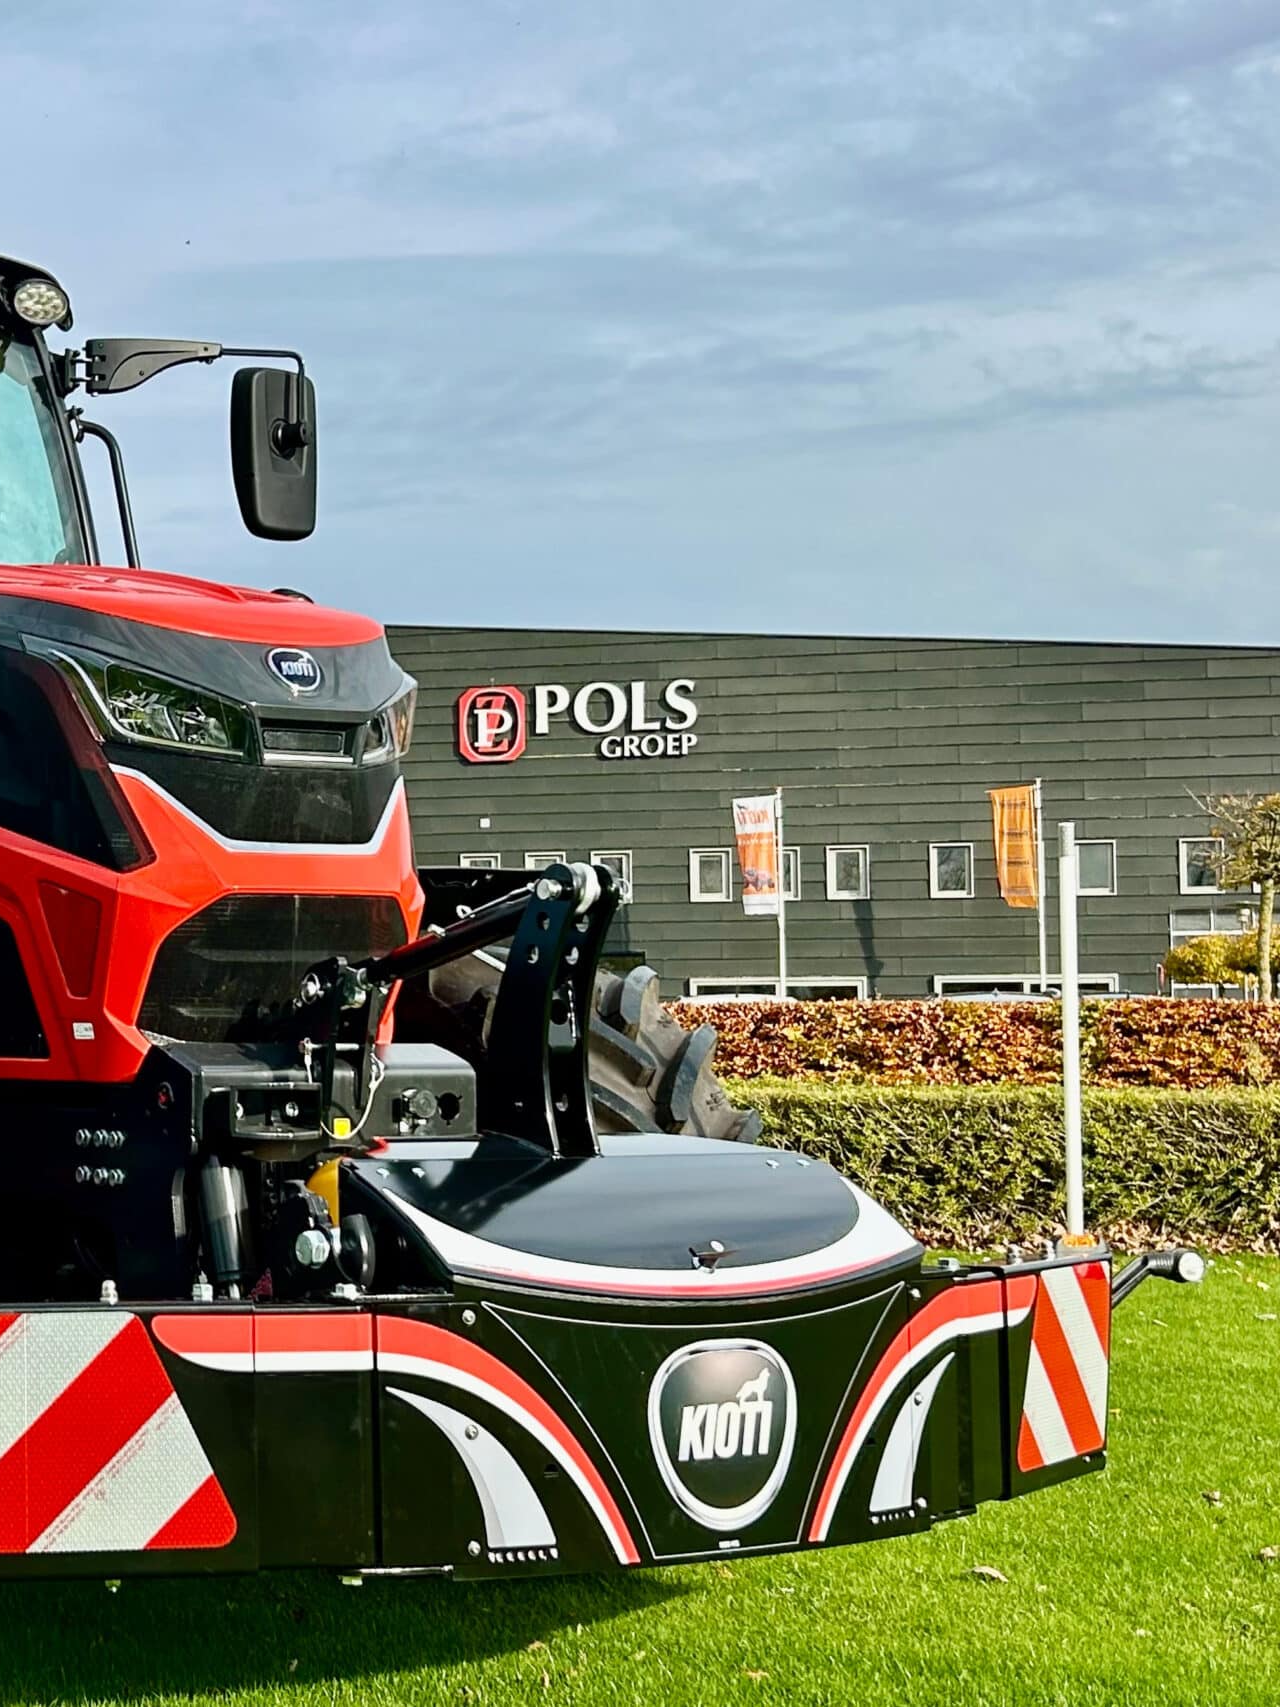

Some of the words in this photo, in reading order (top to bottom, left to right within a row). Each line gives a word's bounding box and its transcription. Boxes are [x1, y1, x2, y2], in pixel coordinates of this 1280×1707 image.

[281, 661, 314, 676] KIOTI
[534, 678, 698, 734] POLS
[600, 733, 698, 758] GROEP
[678, 1400, 774, 1462] KIOTI
